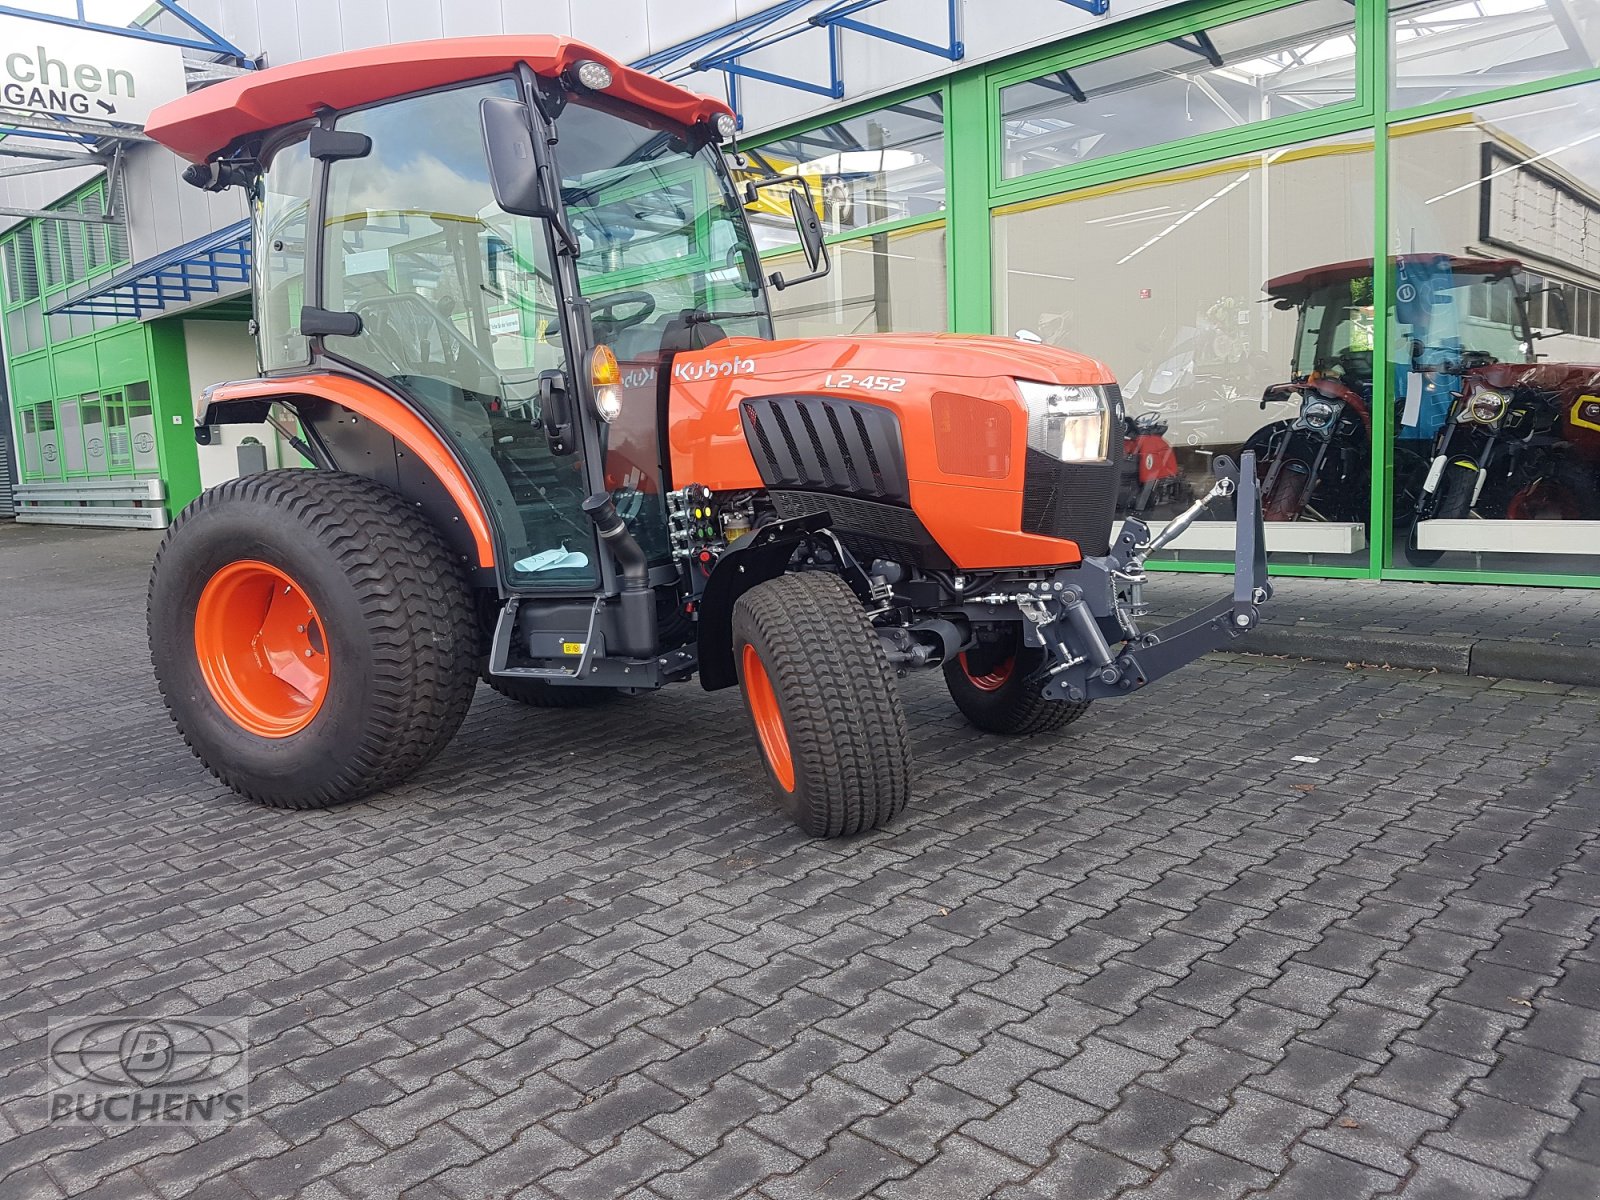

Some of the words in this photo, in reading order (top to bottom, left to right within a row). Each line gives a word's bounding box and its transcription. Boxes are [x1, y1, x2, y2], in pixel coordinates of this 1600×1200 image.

[6, 45, 135, 98] chen
[0, 83, 89, 114] GANG
[675, 355, 755, 381] Kubota
[825, 374, 906, 393] L2-452
